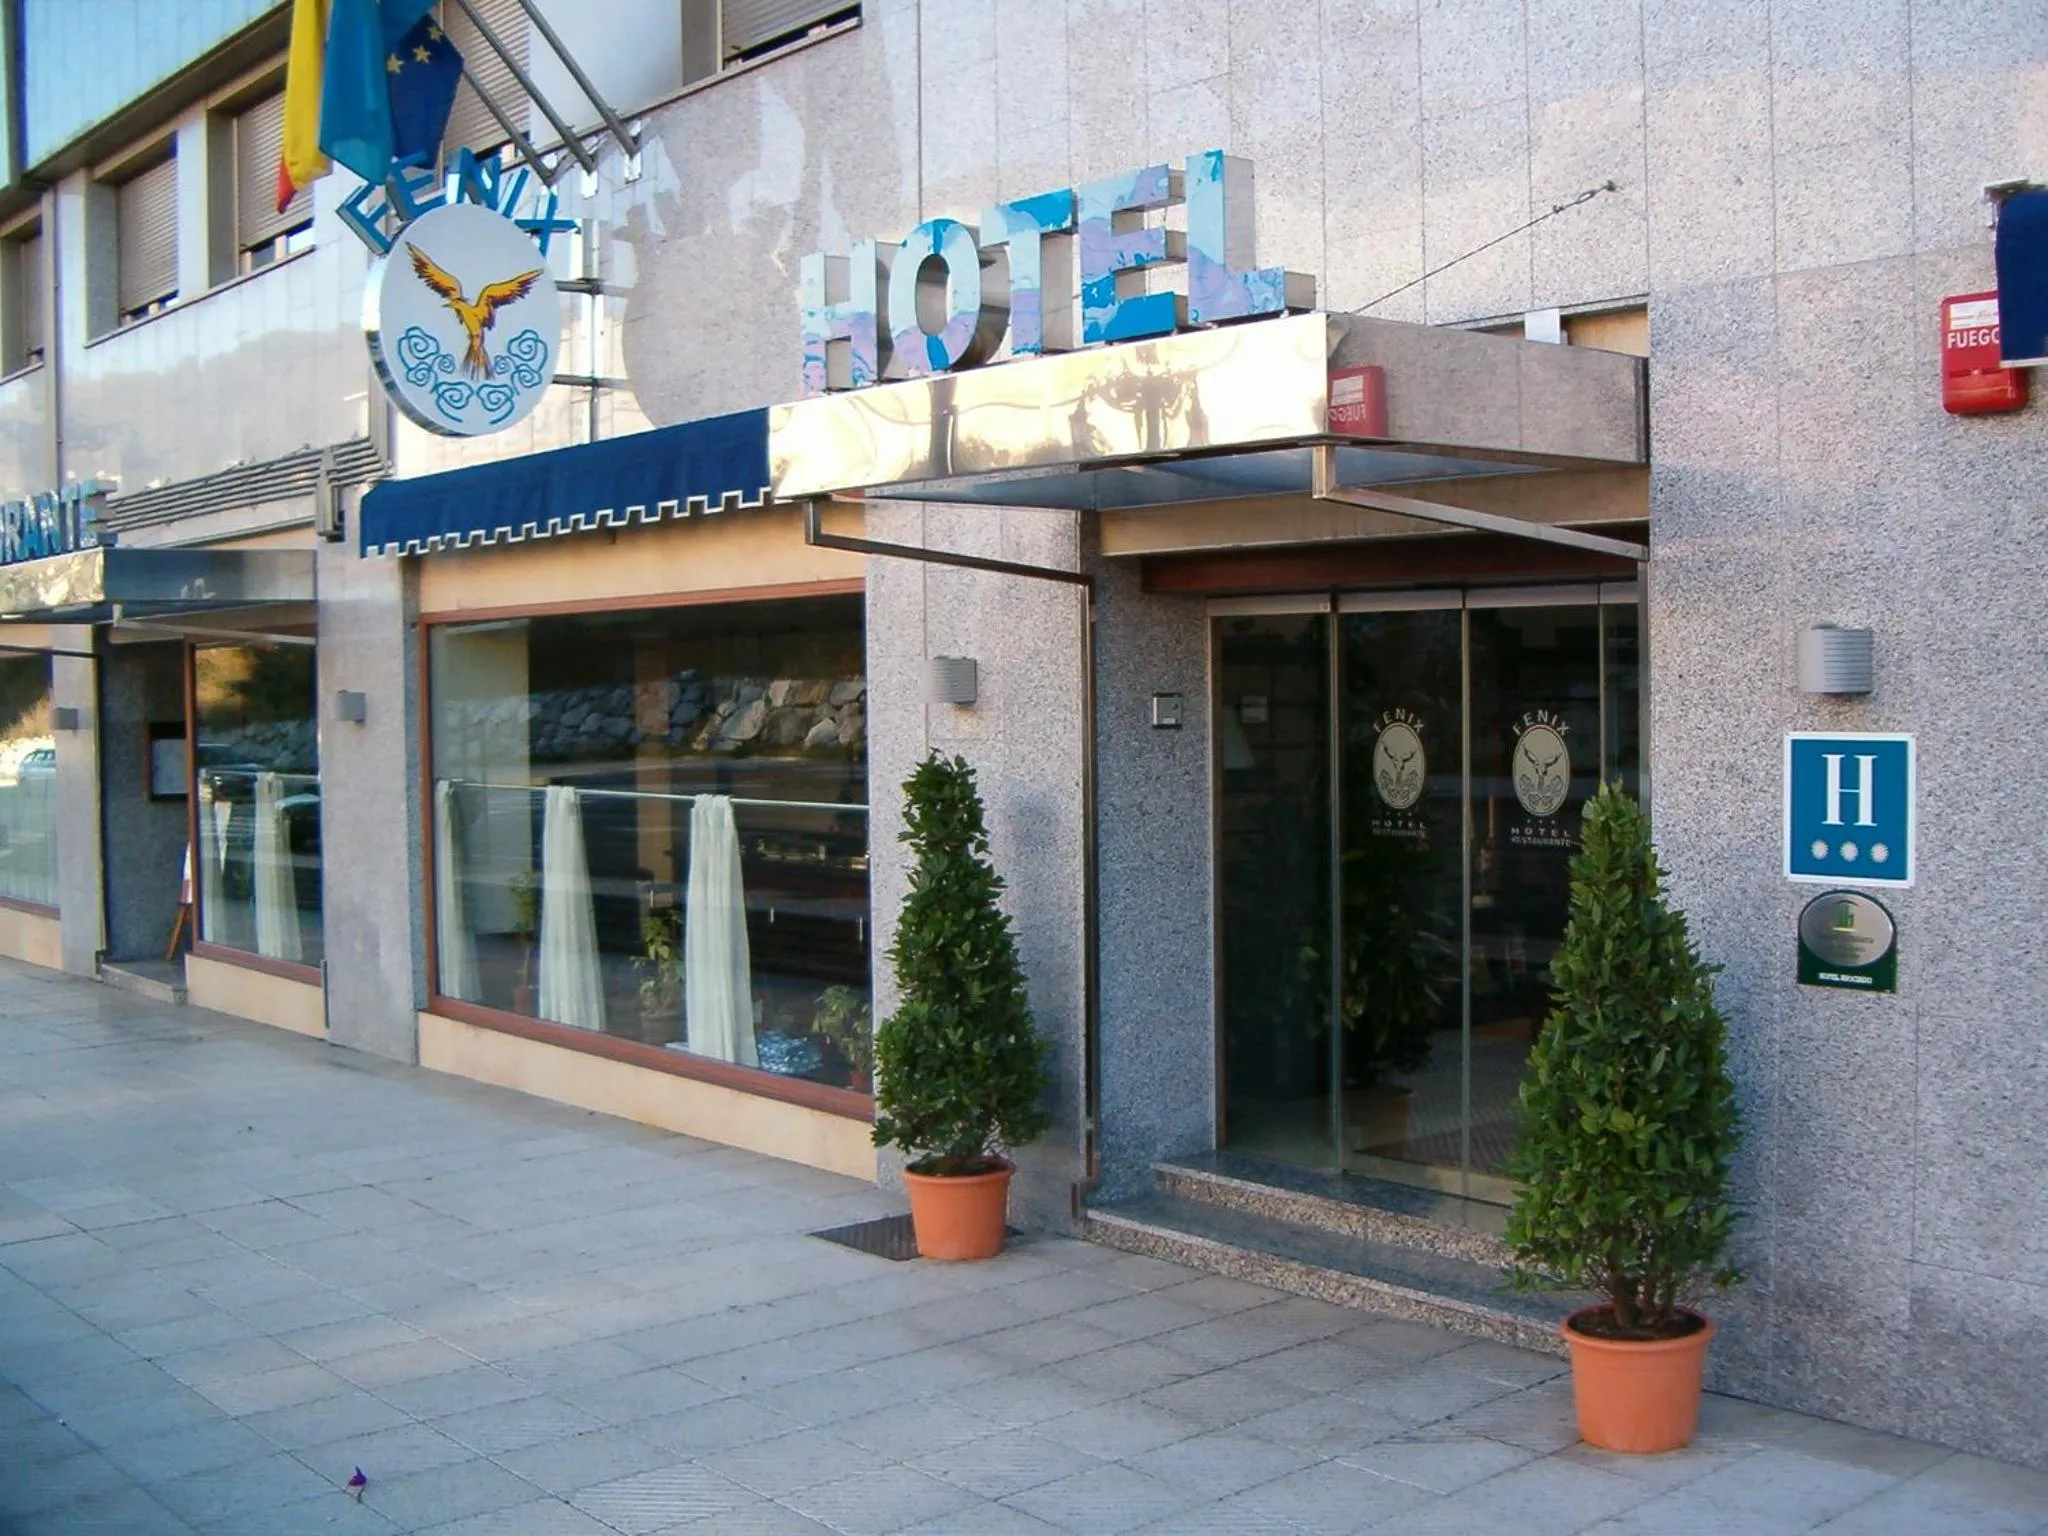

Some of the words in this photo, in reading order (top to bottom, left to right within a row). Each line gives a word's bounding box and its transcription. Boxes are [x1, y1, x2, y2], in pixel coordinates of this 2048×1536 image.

[336, 145, 581, 258] FENIX
[801, 149, 1288, 396] HOTEL
[1372, 708, 1425, 733] FENIX
[1512, 709, 1571, 737] FENIX
[1821, 754, 1879, 826] H
[1510, 826, 1571, 837] HOTEL
